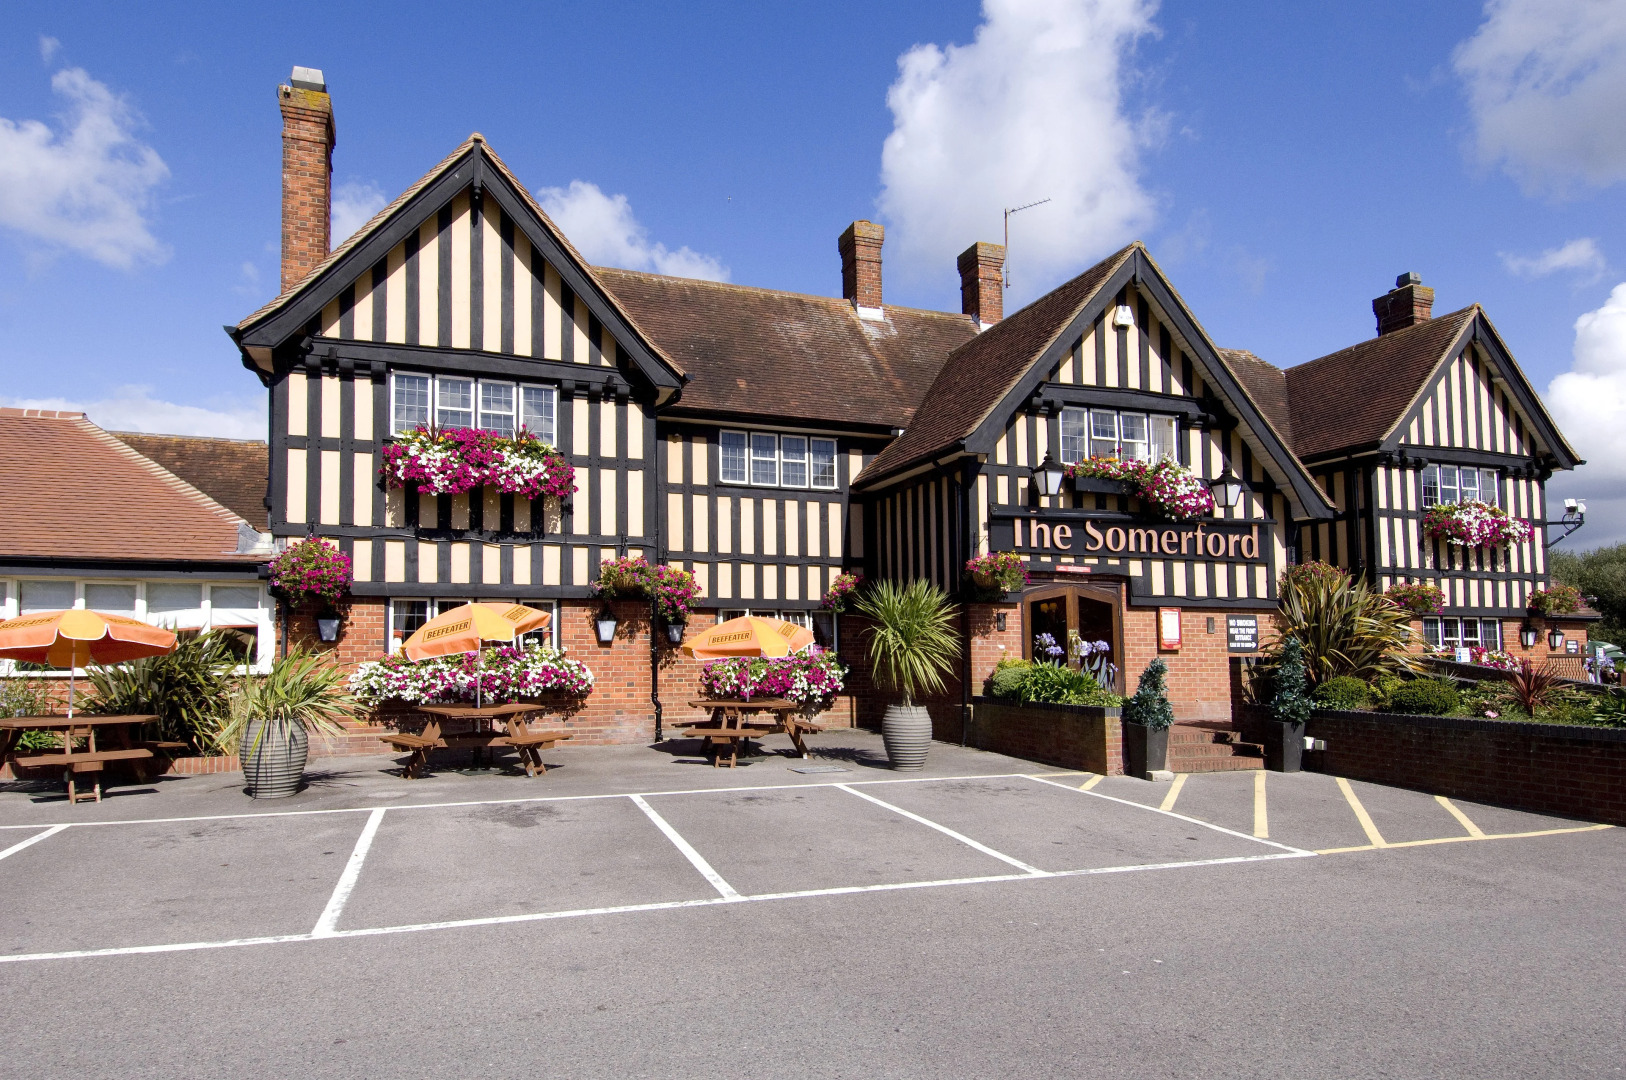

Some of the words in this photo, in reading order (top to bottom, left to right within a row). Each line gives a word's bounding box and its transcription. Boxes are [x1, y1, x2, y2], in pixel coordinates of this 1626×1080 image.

[1014, 517, 1072, 550] The
[1085, 519, 1260, 559] Somerford
[427, 621, 469, 639] BEEFEATER
[712, 632, 750, 643] BEEFEATER
